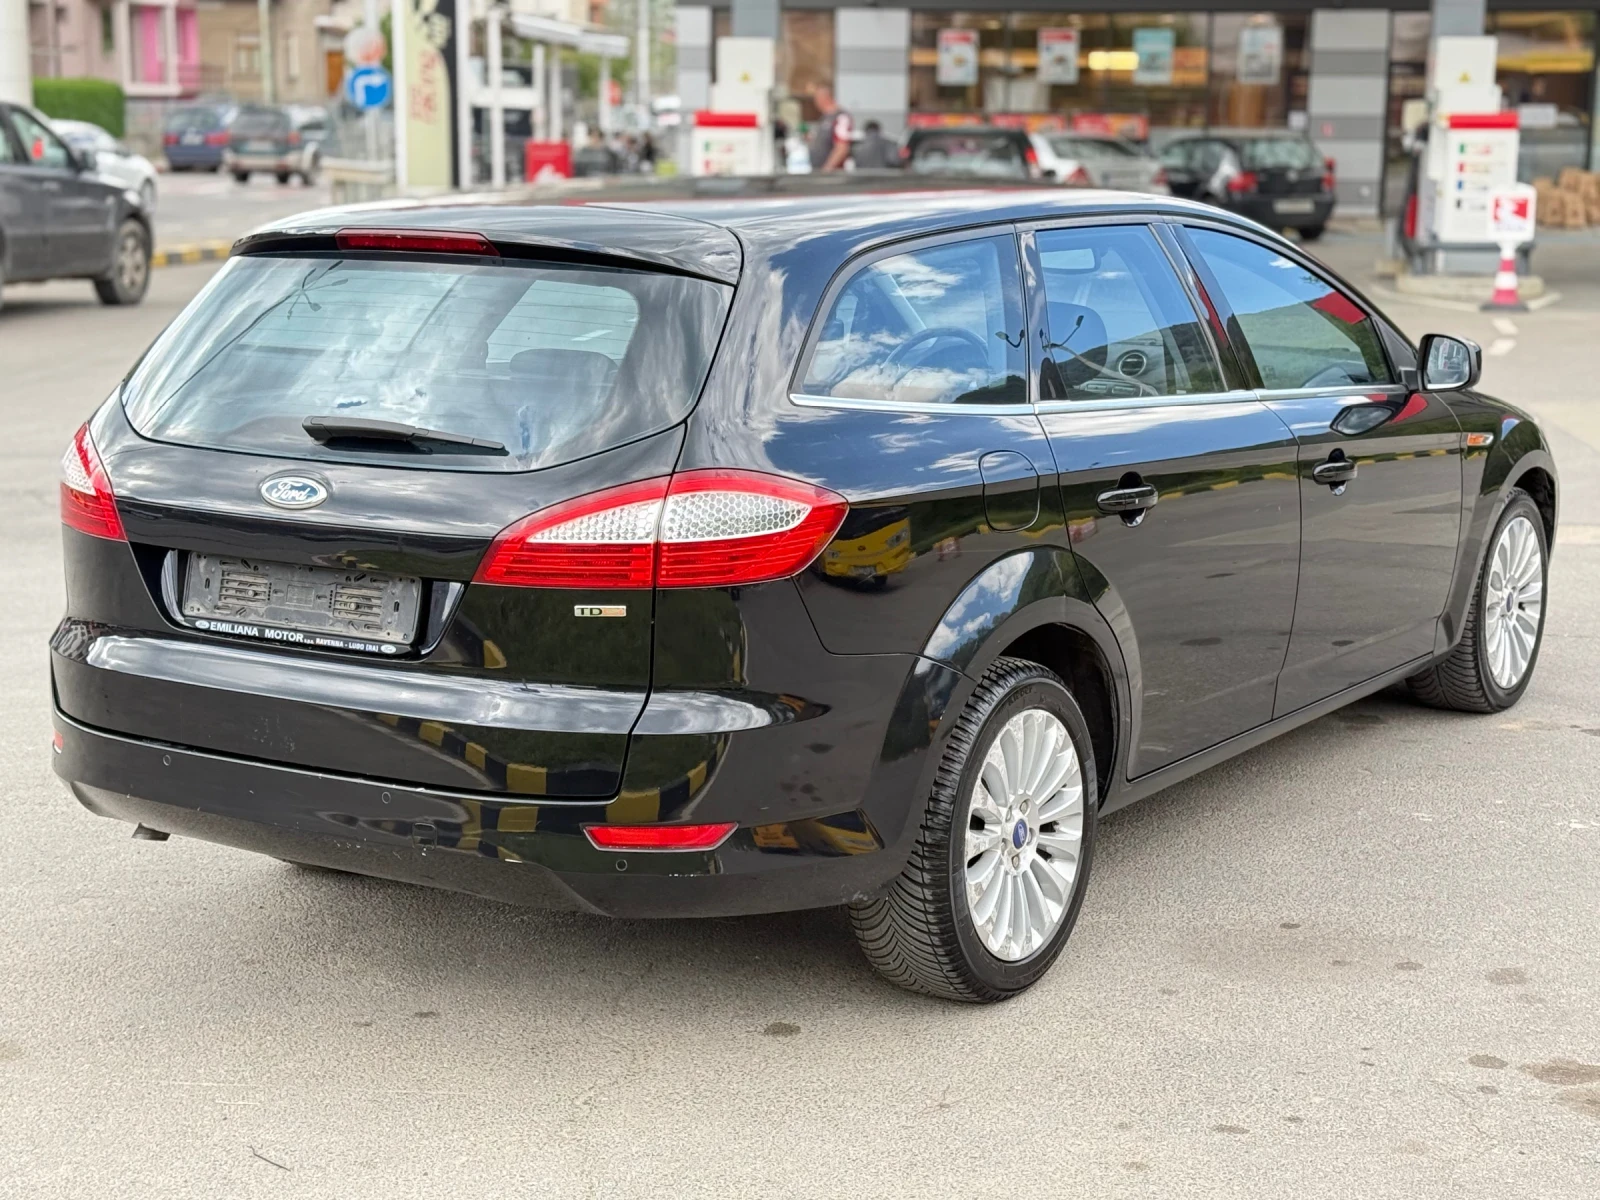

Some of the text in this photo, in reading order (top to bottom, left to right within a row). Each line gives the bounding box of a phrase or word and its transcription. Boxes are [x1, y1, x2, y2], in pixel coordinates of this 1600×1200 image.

[271, 480, 314, 501] Ford
[209, 621, 259, 637] EMILIANA
[264, 629, 304, 643] MOTOR
